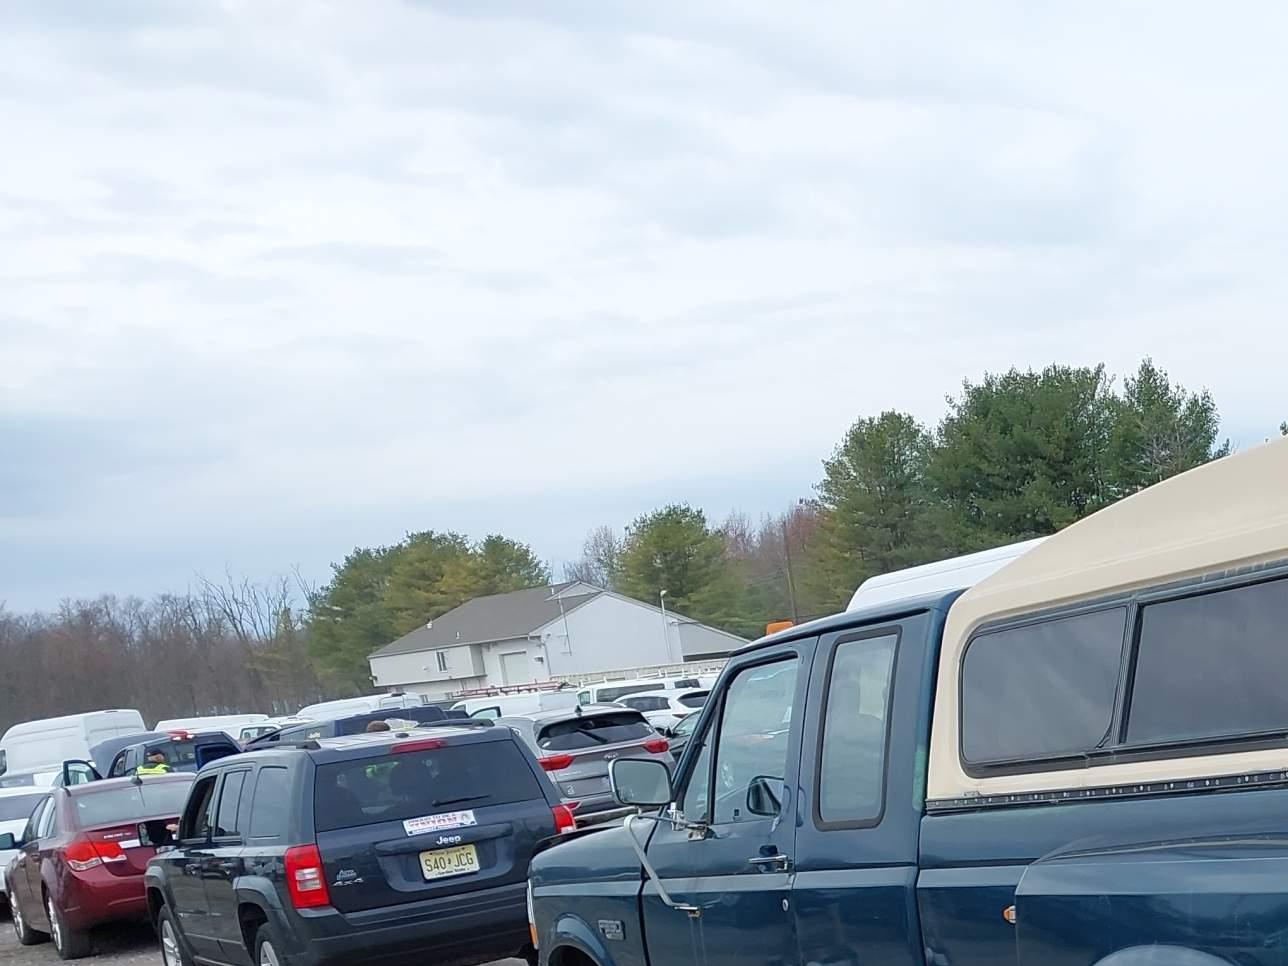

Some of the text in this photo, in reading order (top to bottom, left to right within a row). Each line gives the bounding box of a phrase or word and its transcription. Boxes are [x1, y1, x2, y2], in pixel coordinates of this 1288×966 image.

[436, 835, 461, 845] Jeep
[424, 852, 474, 872] S40 JCG
